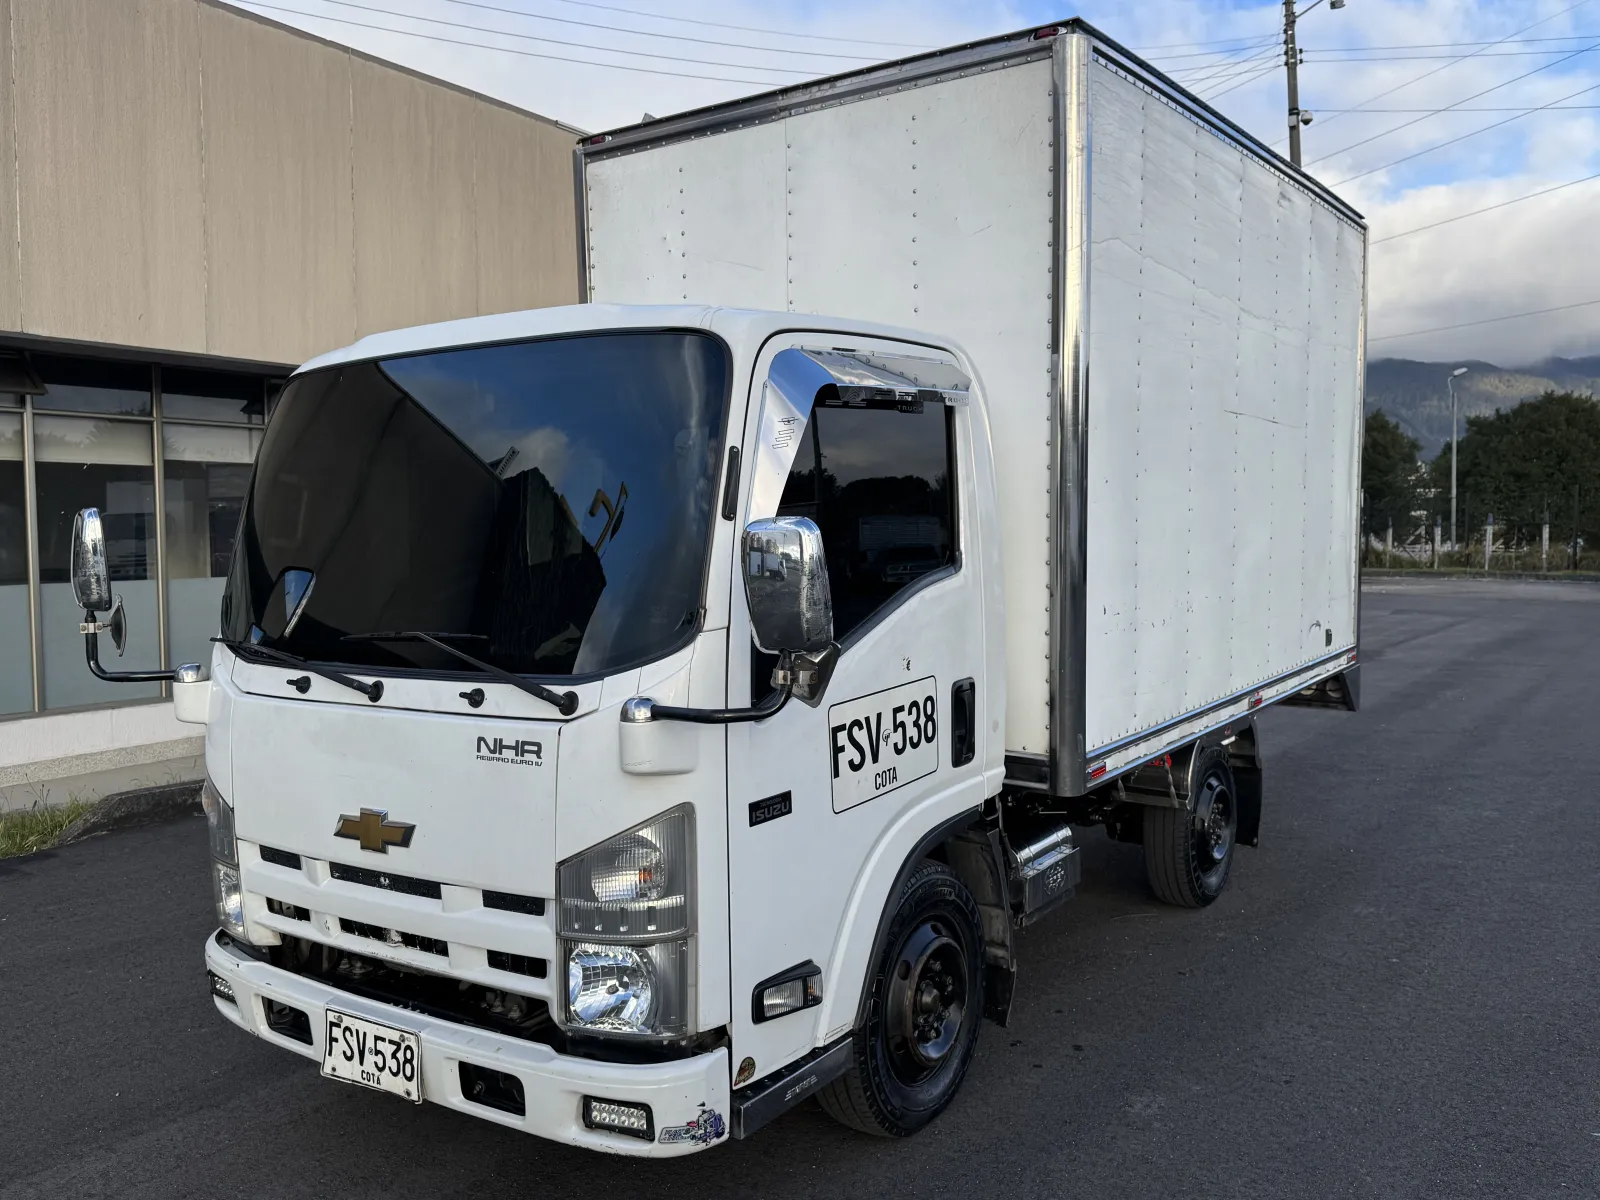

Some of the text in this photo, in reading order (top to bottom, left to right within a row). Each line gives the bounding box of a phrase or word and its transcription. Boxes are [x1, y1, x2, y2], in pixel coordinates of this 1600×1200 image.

[476, 736, 543, 759] NHR
[476, 754, 510, 763] REWARD
[510, 758, 534, 767] EURO
[874, 766, 898, 790] COTA
[752, 801, 789, 822] ISUZU
[361, 1069, 382, 1086] COTA
